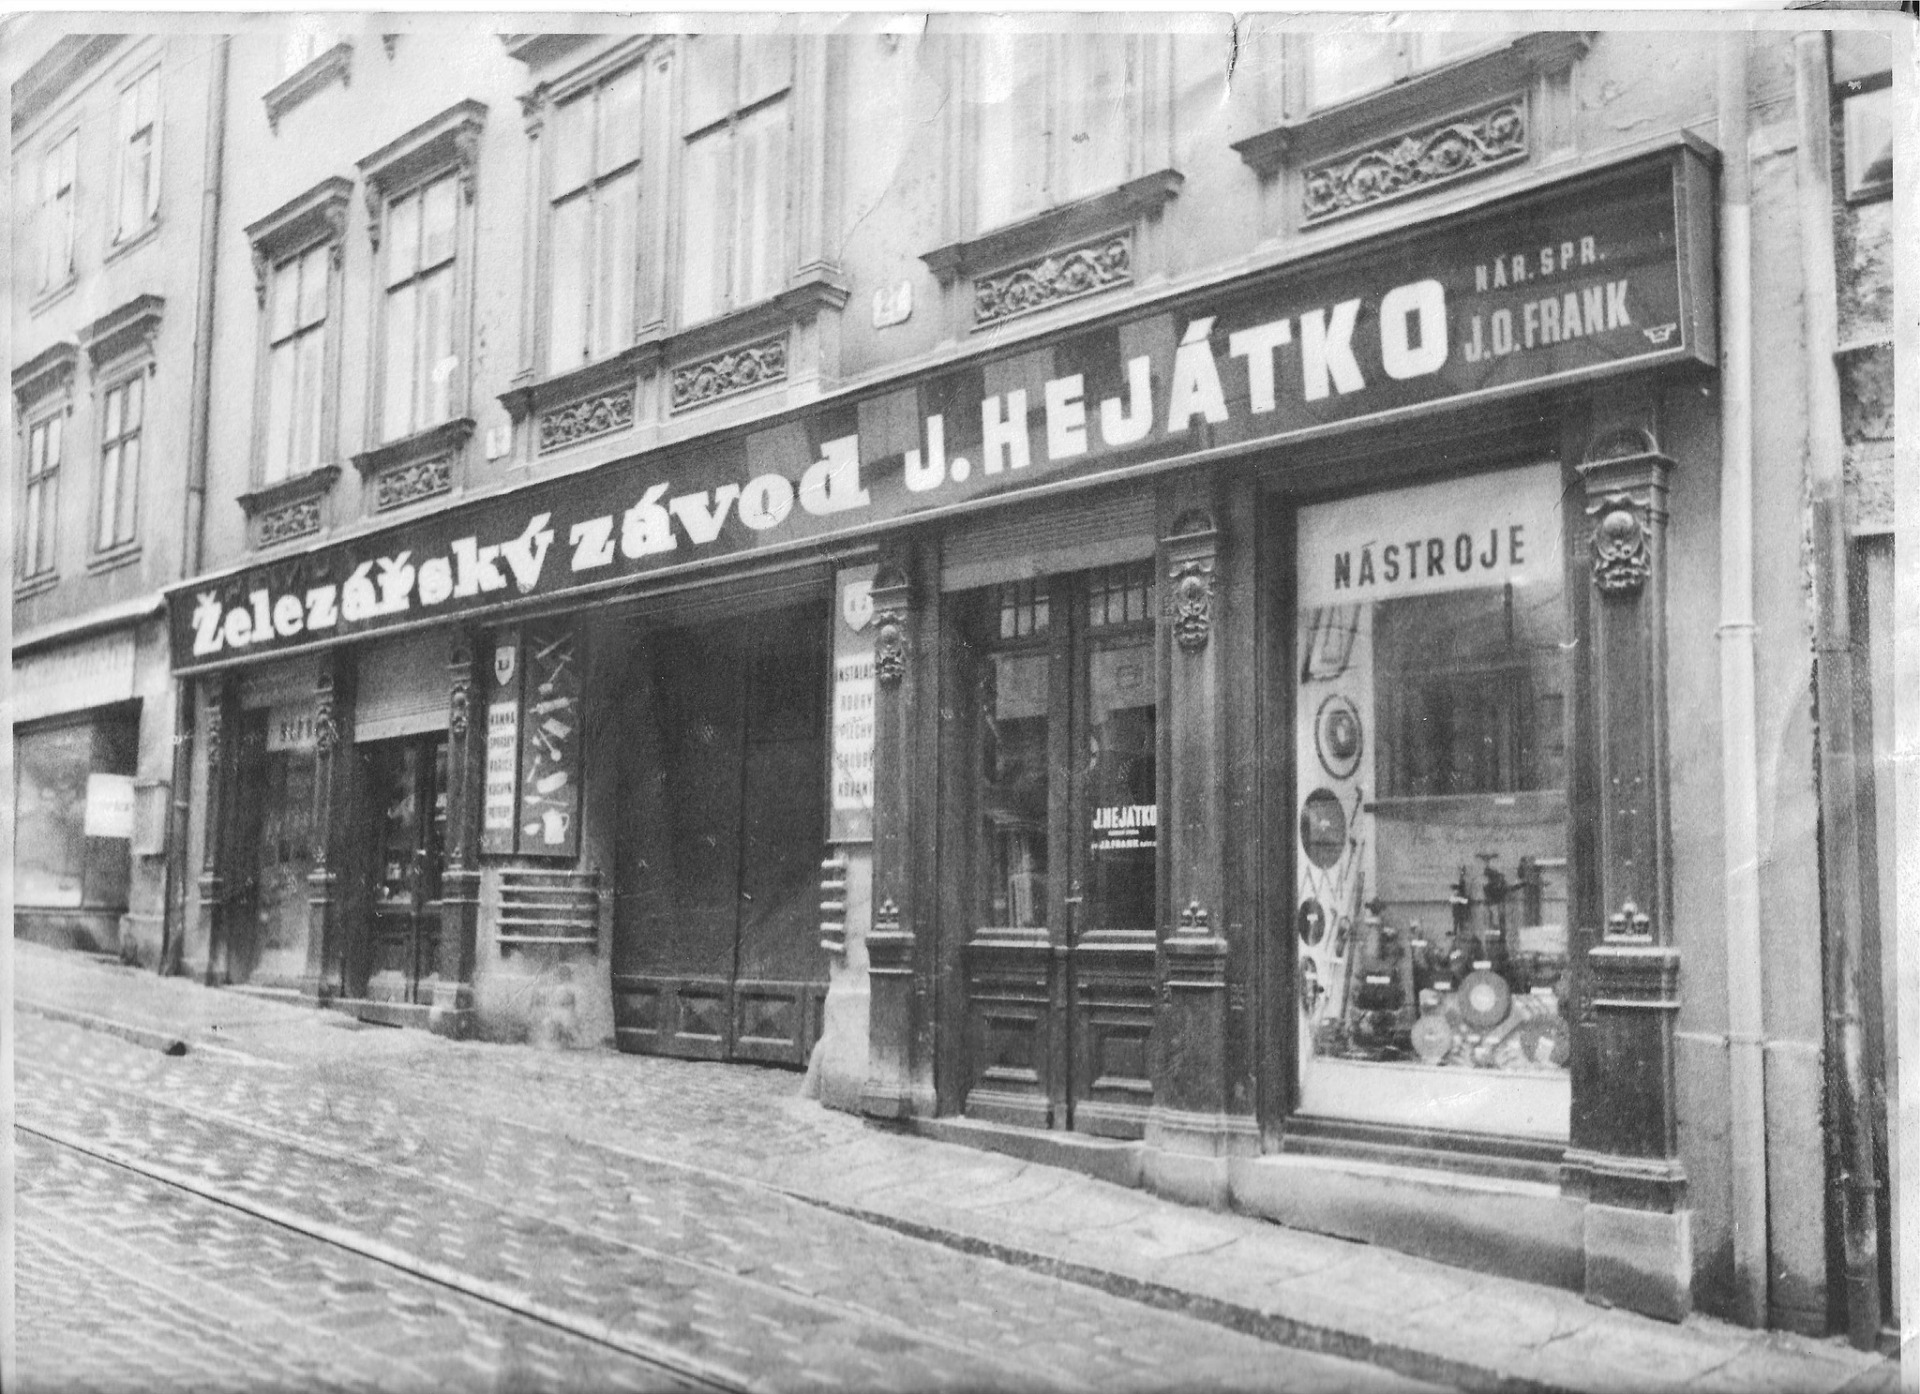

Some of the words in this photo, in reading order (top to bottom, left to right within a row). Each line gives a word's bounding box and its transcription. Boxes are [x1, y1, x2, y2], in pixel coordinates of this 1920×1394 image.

[191, 510, 556, 657] Železářský
[569, 432, 872, 573] závod
[1334, 523, 1526, 592] NÁSTROJE
